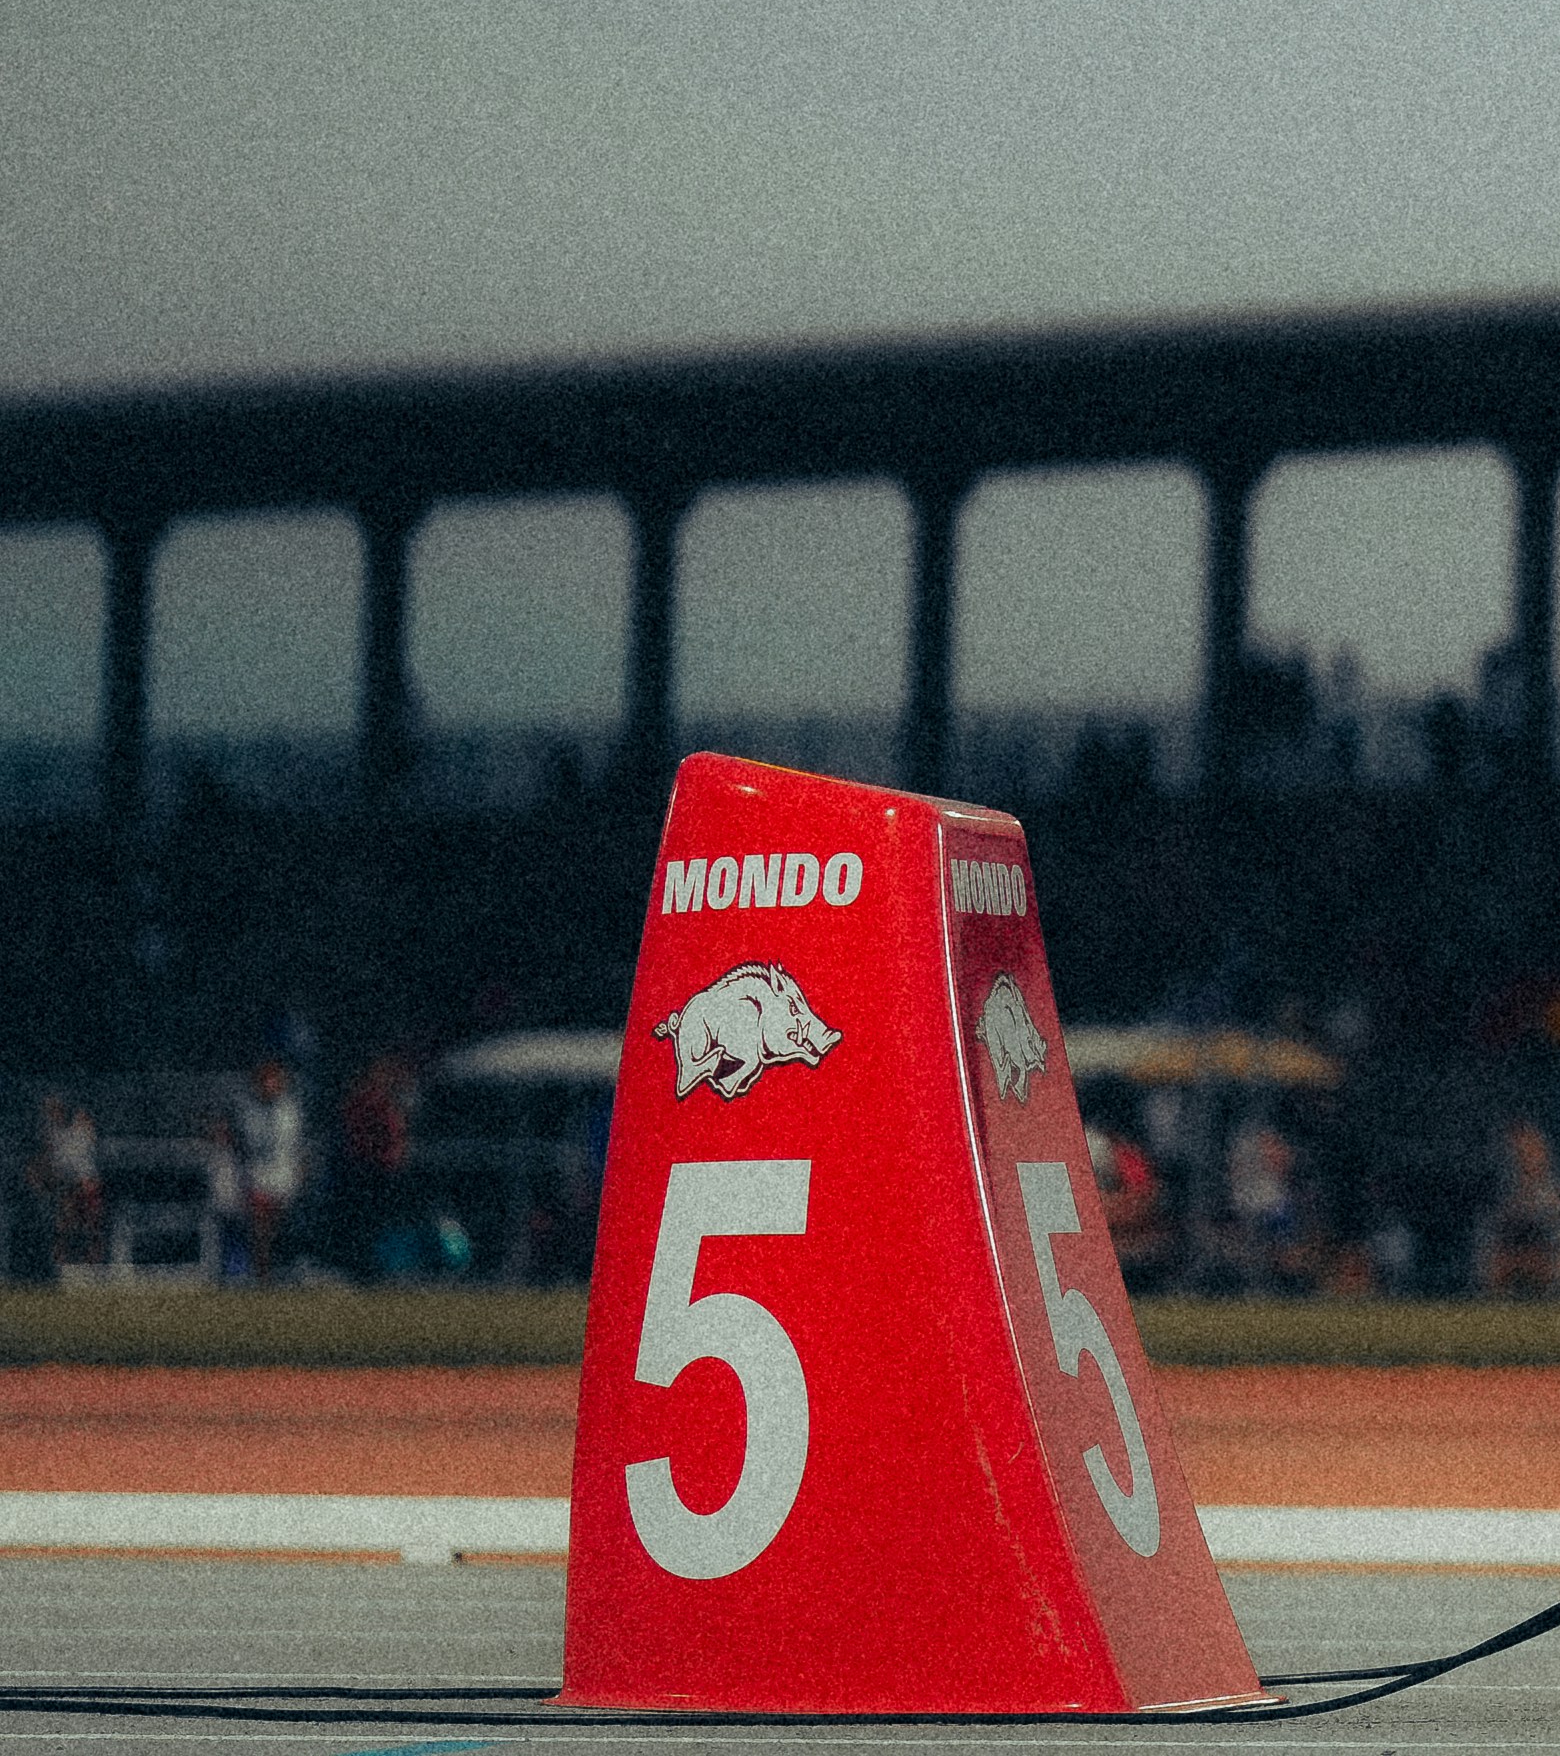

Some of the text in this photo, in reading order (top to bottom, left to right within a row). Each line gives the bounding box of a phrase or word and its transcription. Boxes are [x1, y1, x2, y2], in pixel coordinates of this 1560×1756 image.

[661, 852, 864, 915] MONDO
[951, 858, 1027, 917] MONDO
[624, 1159, 812, 1580] 5
[1017, 1161, 1161, 1558] 5
